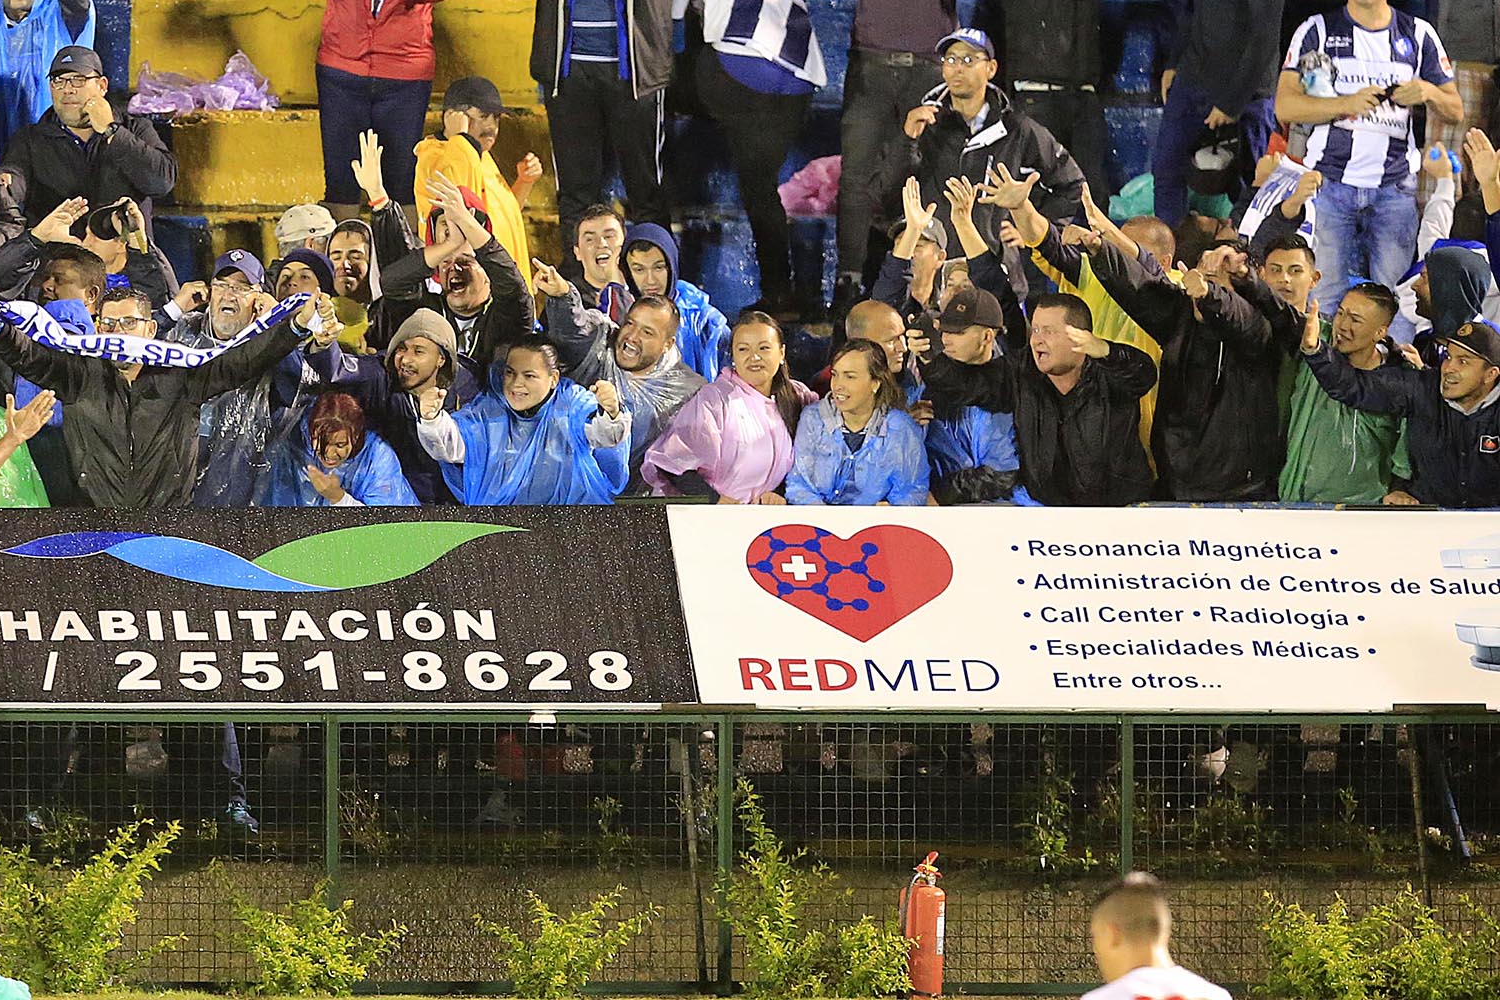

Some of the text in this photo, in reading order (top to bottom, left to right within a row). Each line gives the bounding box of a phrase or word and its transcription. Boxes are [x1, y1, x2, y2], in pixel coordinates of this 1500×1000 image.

[44, 325, 125, 353] CLUB
[1028, 539, 1322, 562] Resonancia Magnética
[1034, 573, 1500, 595] Administración de Centros de Salud
[1040, 606, 1349, 630] Call Center Radiología
[1046, 638, 1360, 660] Especialidades Médicas
[114, 650, 633, 692] 2551-8628
[738, 657, 1000, 692] REDMED
[1053, 672, 1222, 689] Entre otros...
